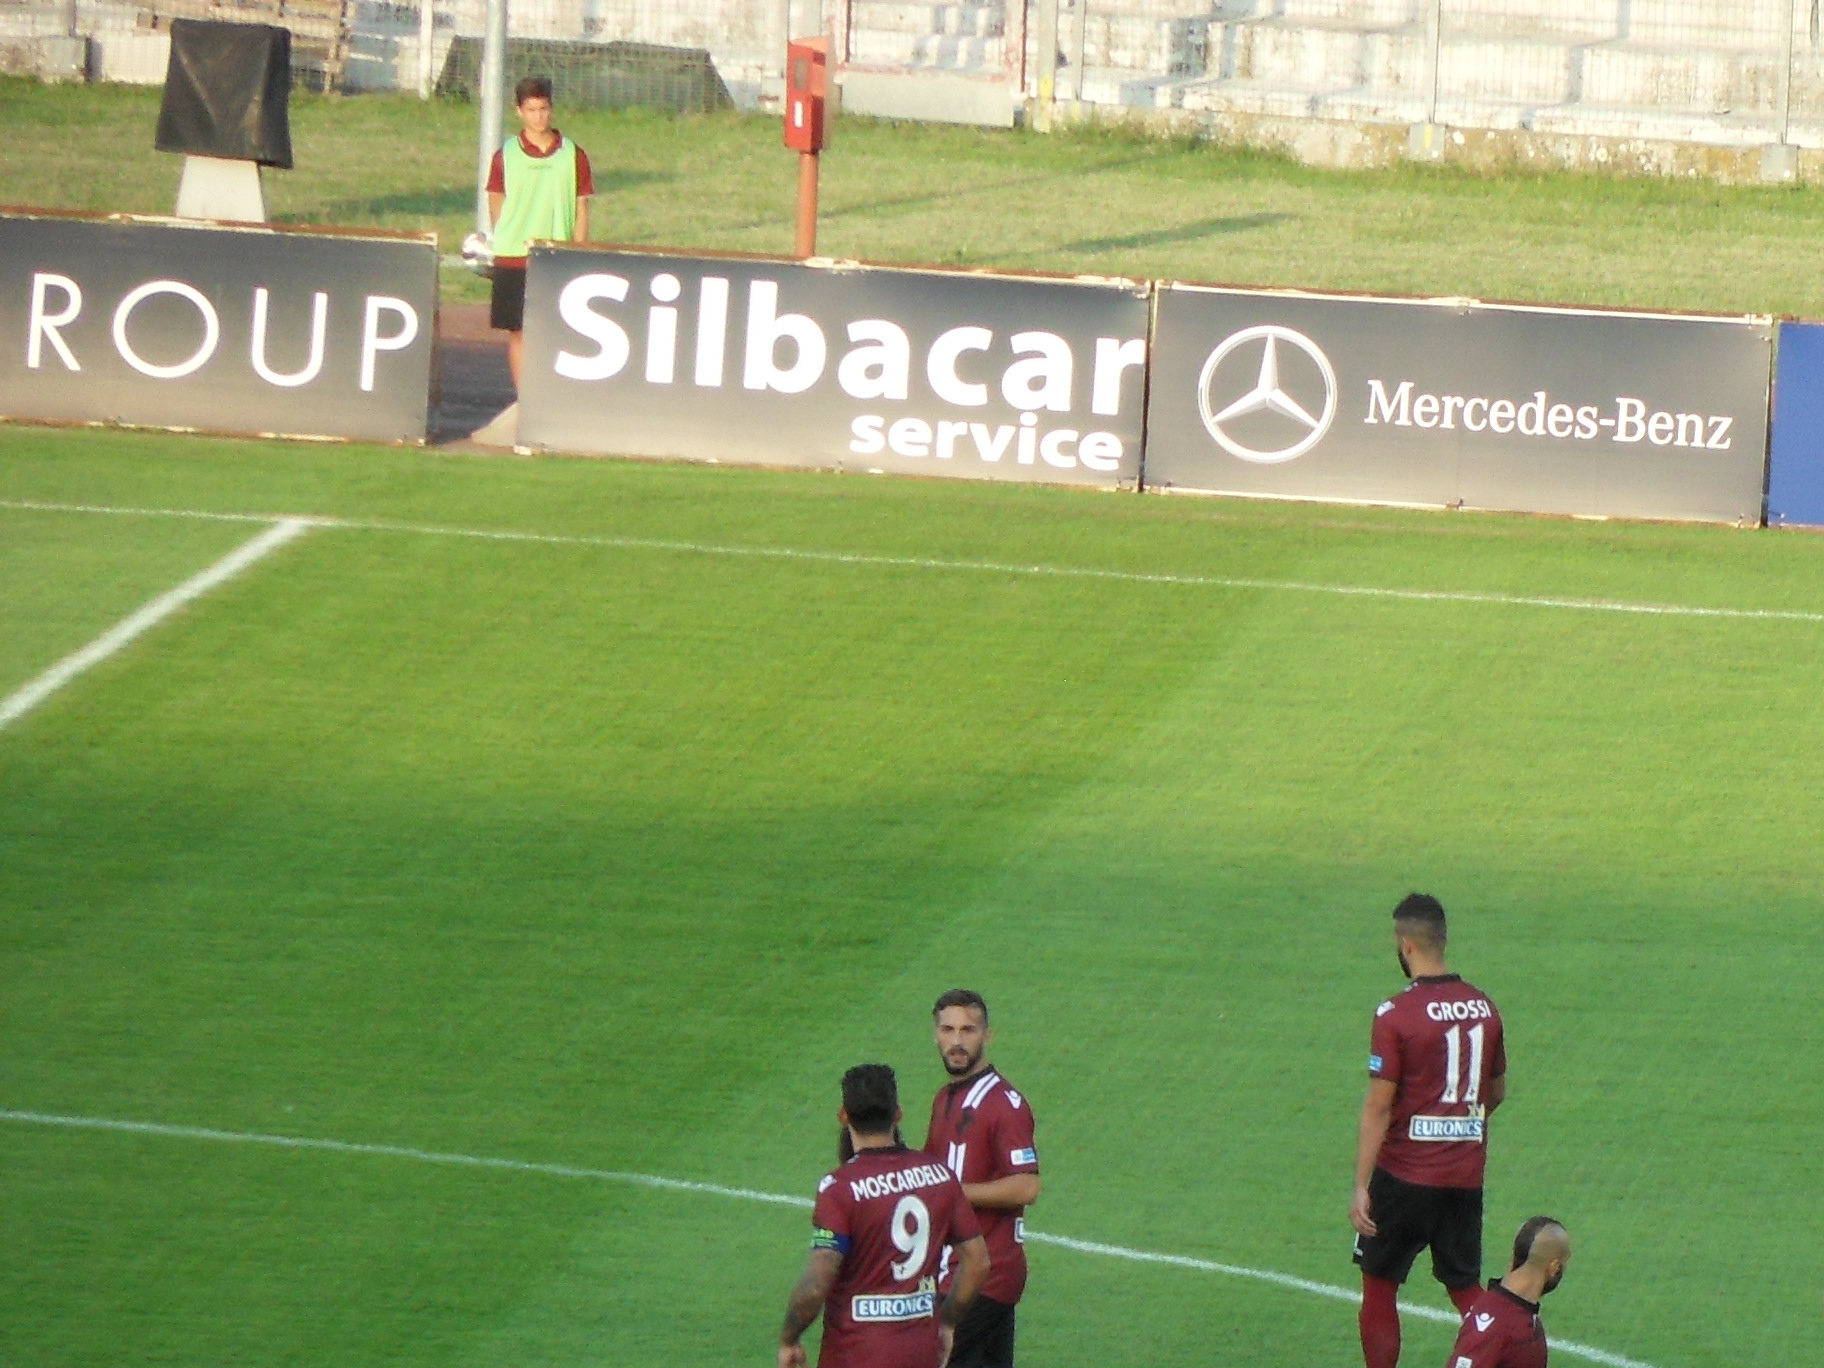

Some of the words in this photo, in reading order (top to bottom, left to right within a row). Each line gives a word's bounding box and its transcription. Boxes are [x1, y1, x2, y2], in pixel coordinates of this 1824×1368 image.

[27, 272, 419, 392] ROUP
[553, 271, 1145, 415] Silbacar
[847, 412, 1123, 471] service
[1363, 379, 1733, 450] Mercedes-Benz
[1426, 1000, 1492, 1021] GROSSI
[1440, 1023, 1484, 1104] 11
[850, 1163, 950, 1202] MOSCARDELLI
[890, 1194, 930, 1281] 9
